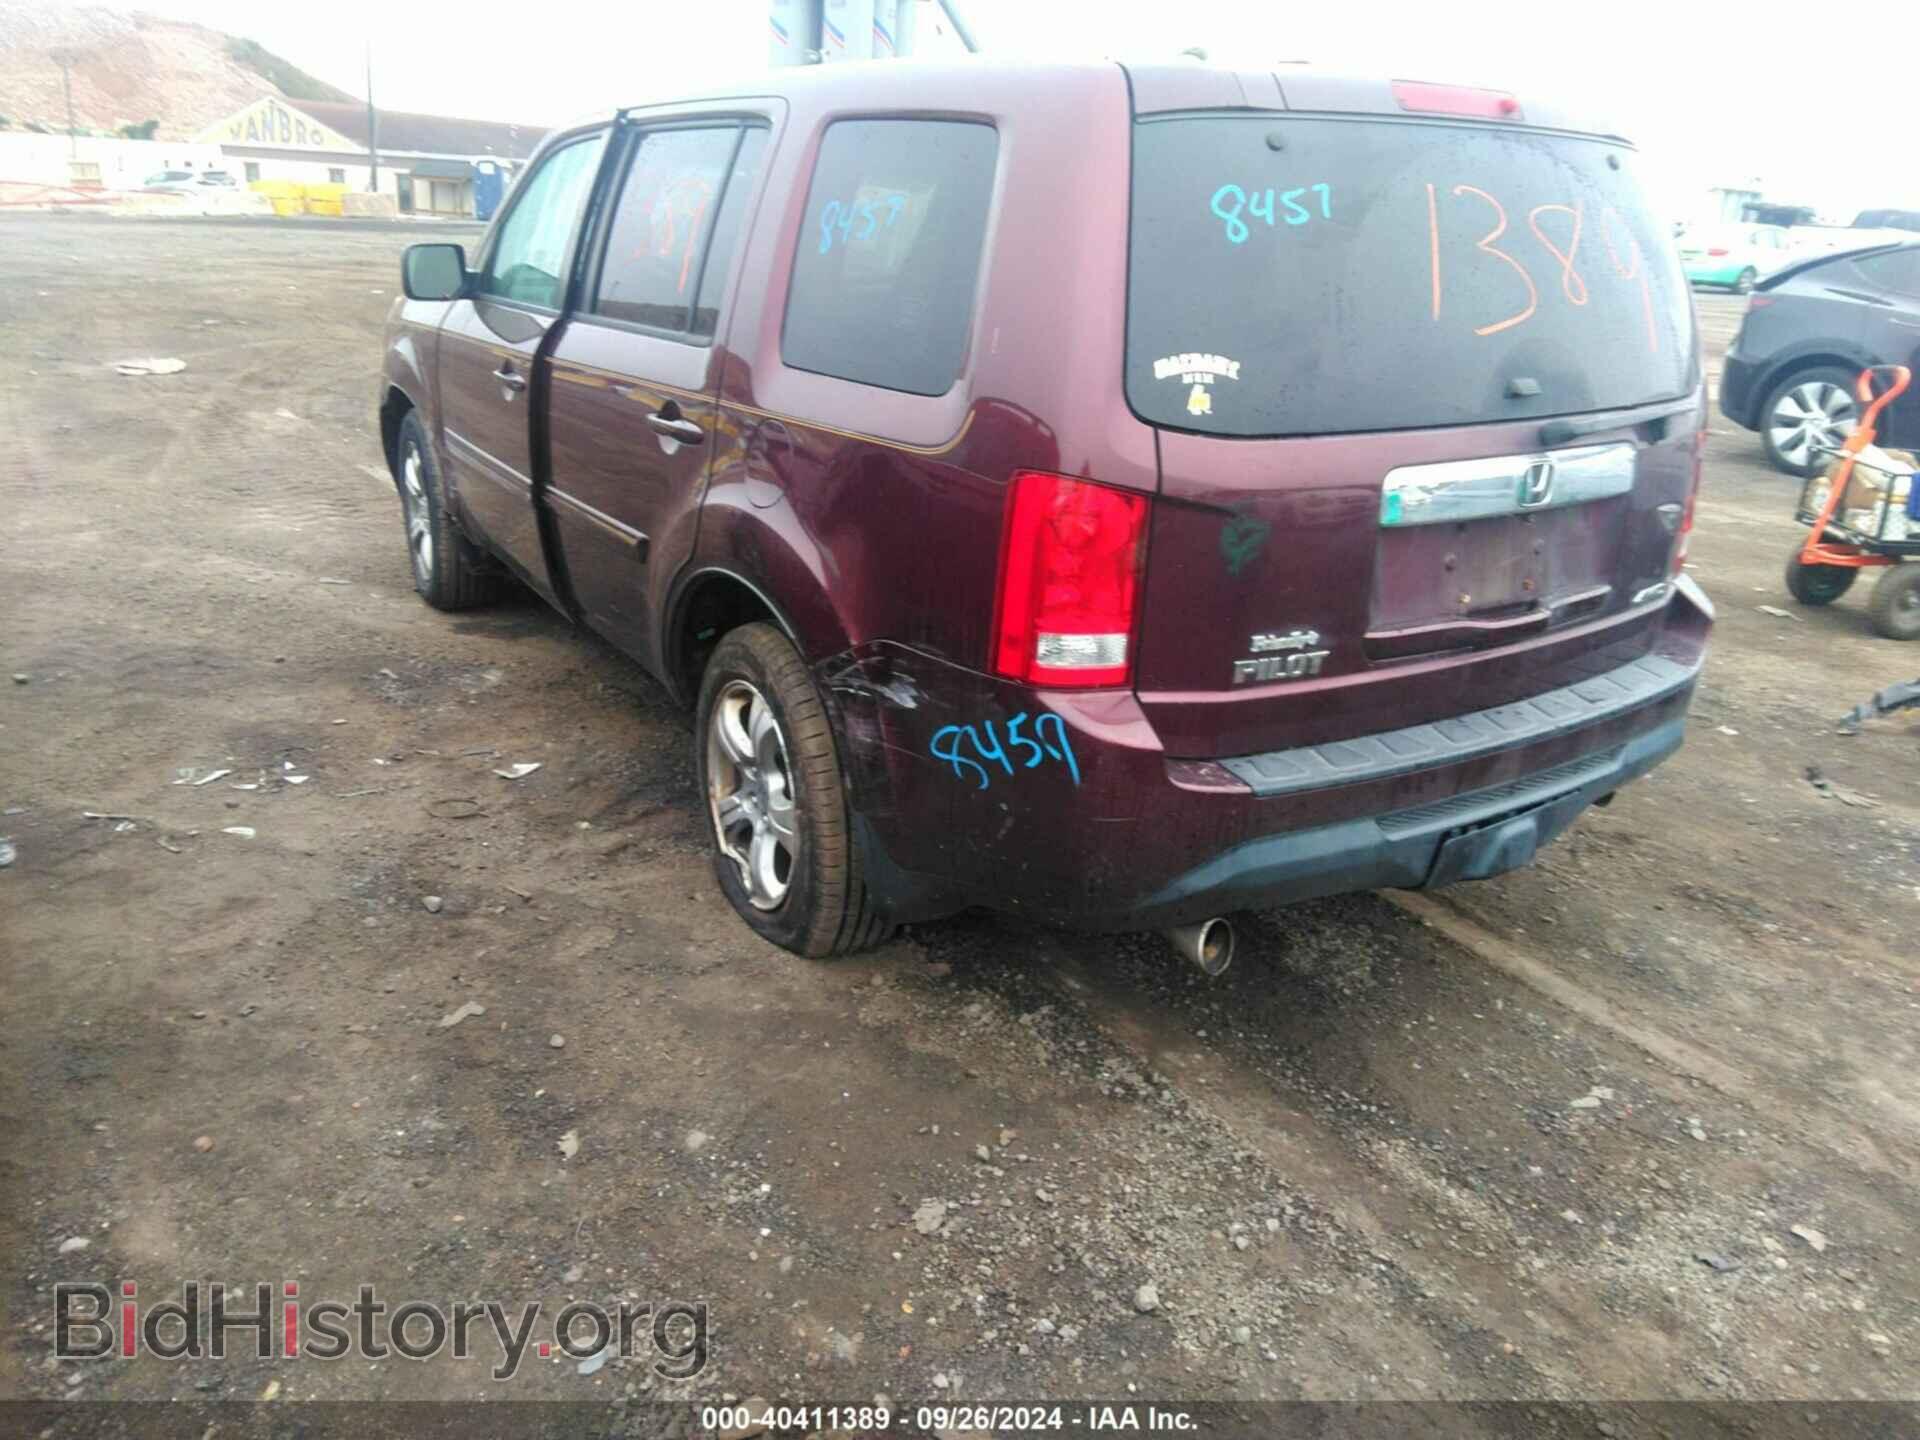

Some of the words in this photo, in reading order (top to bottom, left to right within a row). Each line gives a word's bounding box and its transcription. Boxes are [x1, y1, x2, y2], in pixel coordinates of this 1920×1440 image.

[229, 103, 324, 146] VANBRO
[1210, 183, 1333, 244] 8457
[1232, 650, 1331, 684] PILOT
